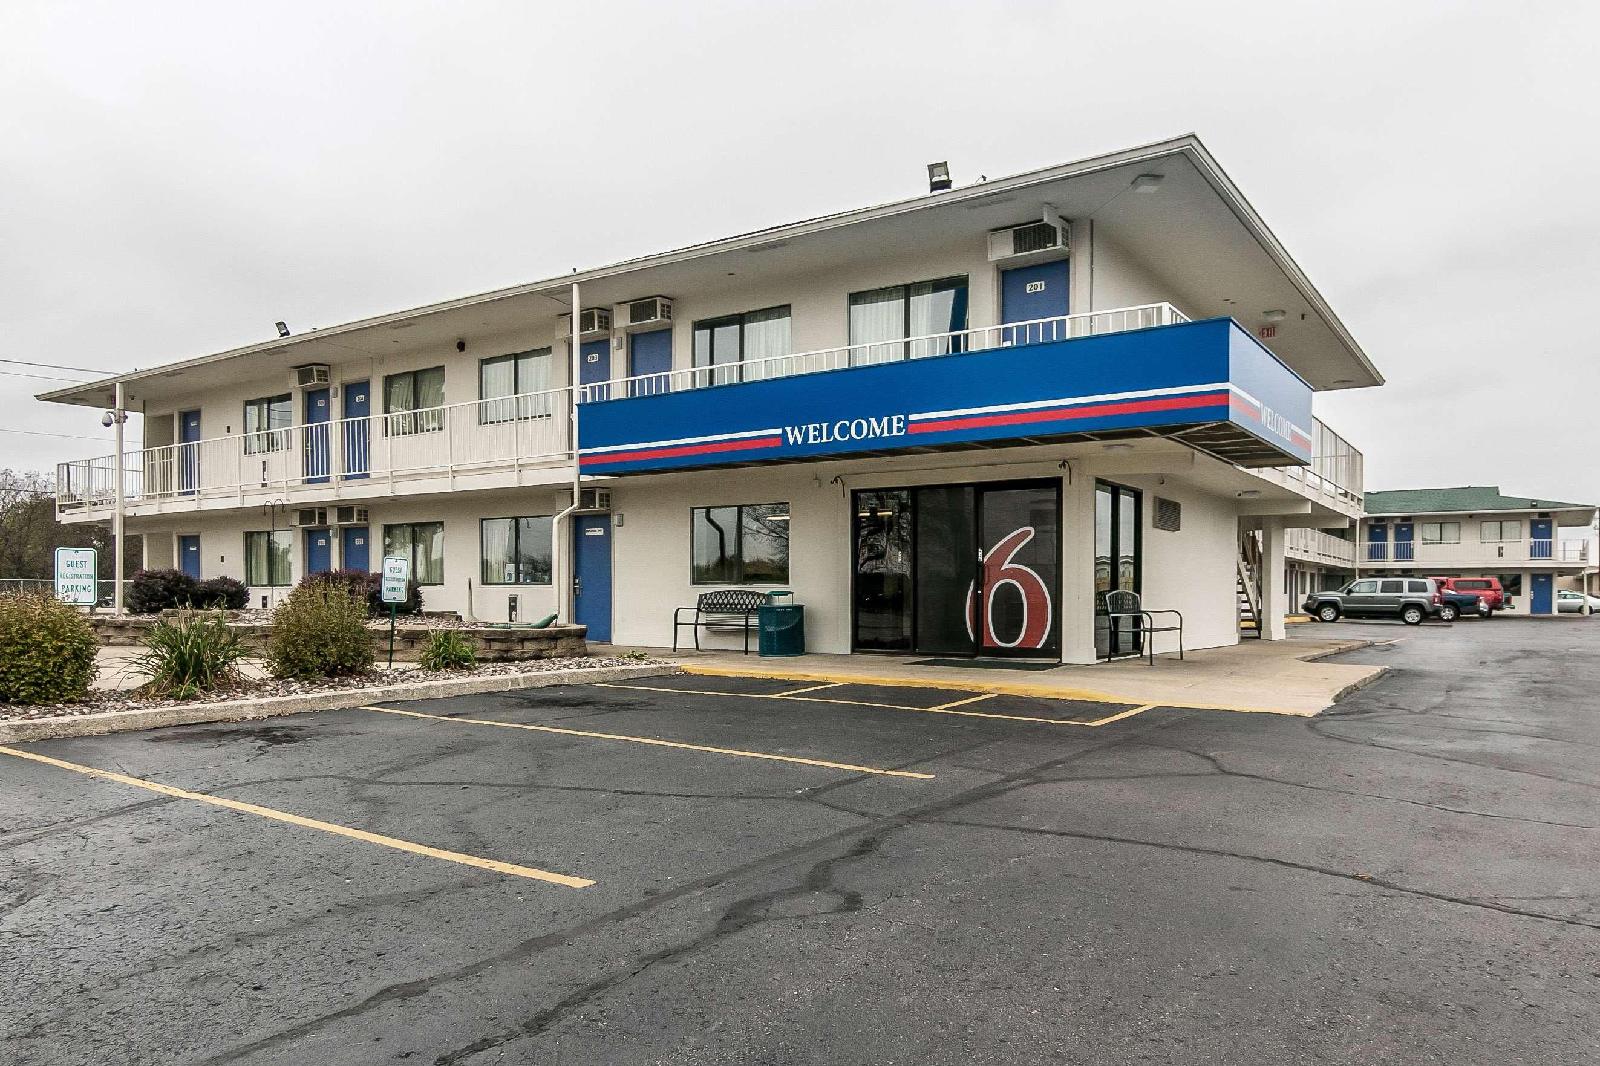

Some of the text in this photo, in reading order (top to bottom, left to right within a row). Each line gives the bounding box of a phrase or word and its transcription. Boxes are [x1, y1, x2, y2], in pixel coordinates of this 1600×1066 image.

[1027, 281, 1043, 292] 201
[784, 414, 906, 446] WELCOME
[1260, 400, 1292, 442] WELCOME
[66, 560, 88, 568] GUEST
[61, 584, 92, 593] PARKING
[965, 526, 1052, 649] 6
